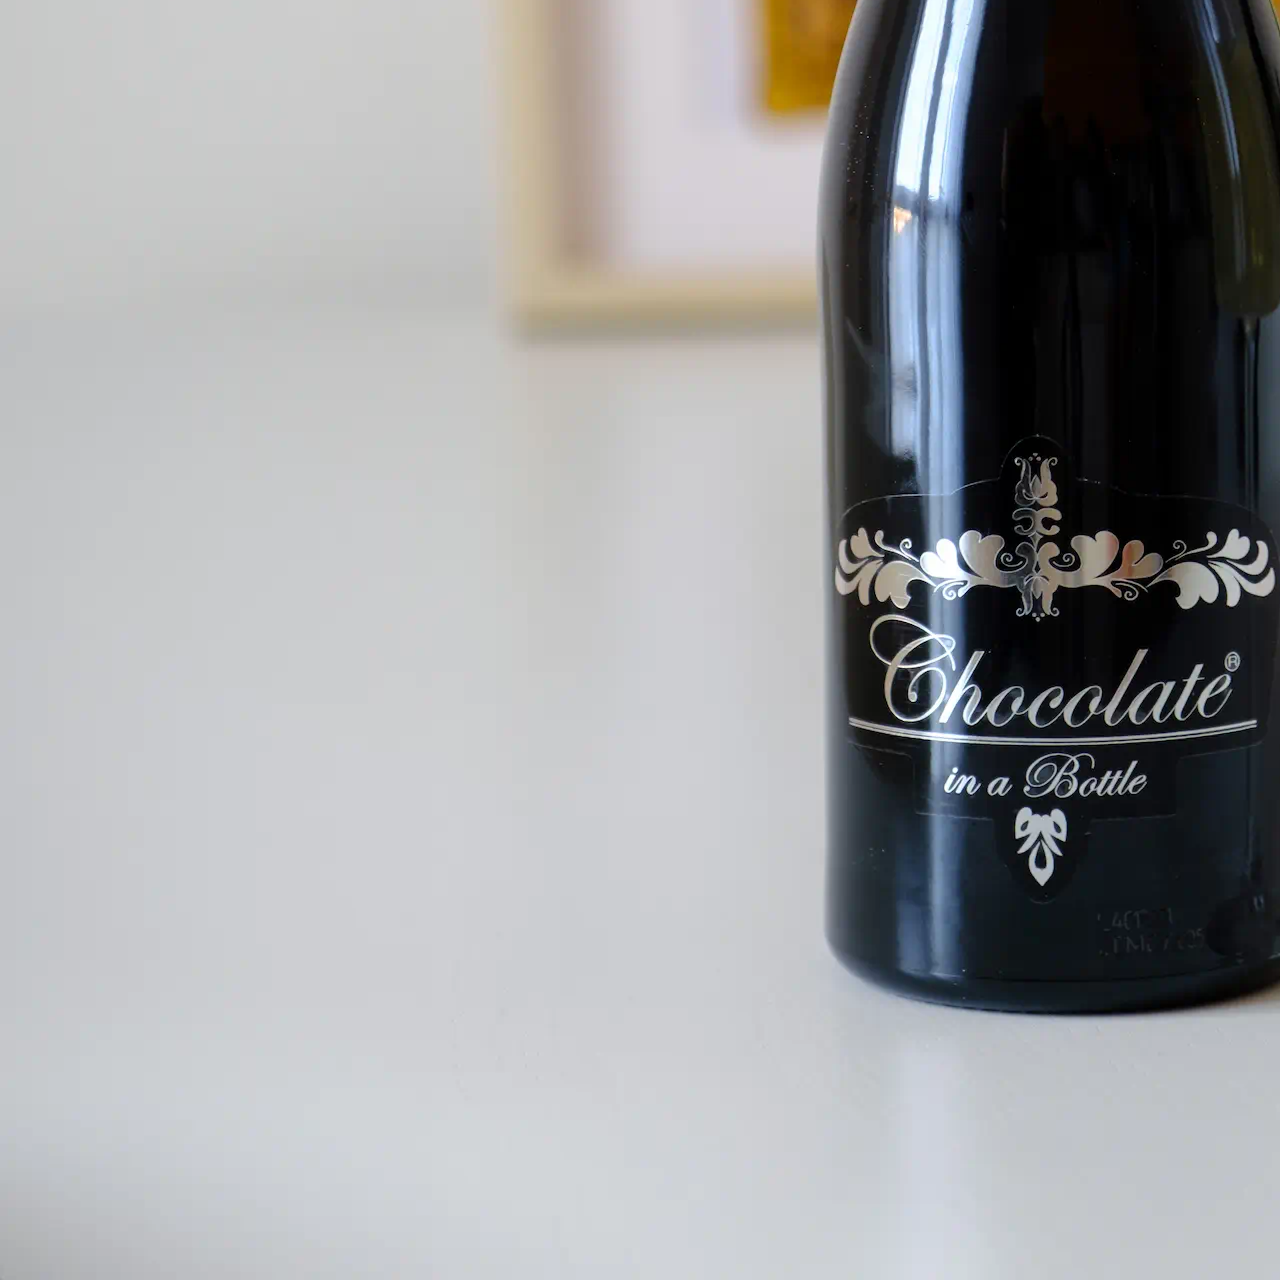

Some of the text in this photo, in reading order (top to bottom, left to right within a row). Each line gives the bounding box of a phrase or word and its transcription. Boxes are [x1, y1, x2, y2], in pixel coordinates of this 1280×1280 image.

[943, 753, 1148, 799] in a Bottle
